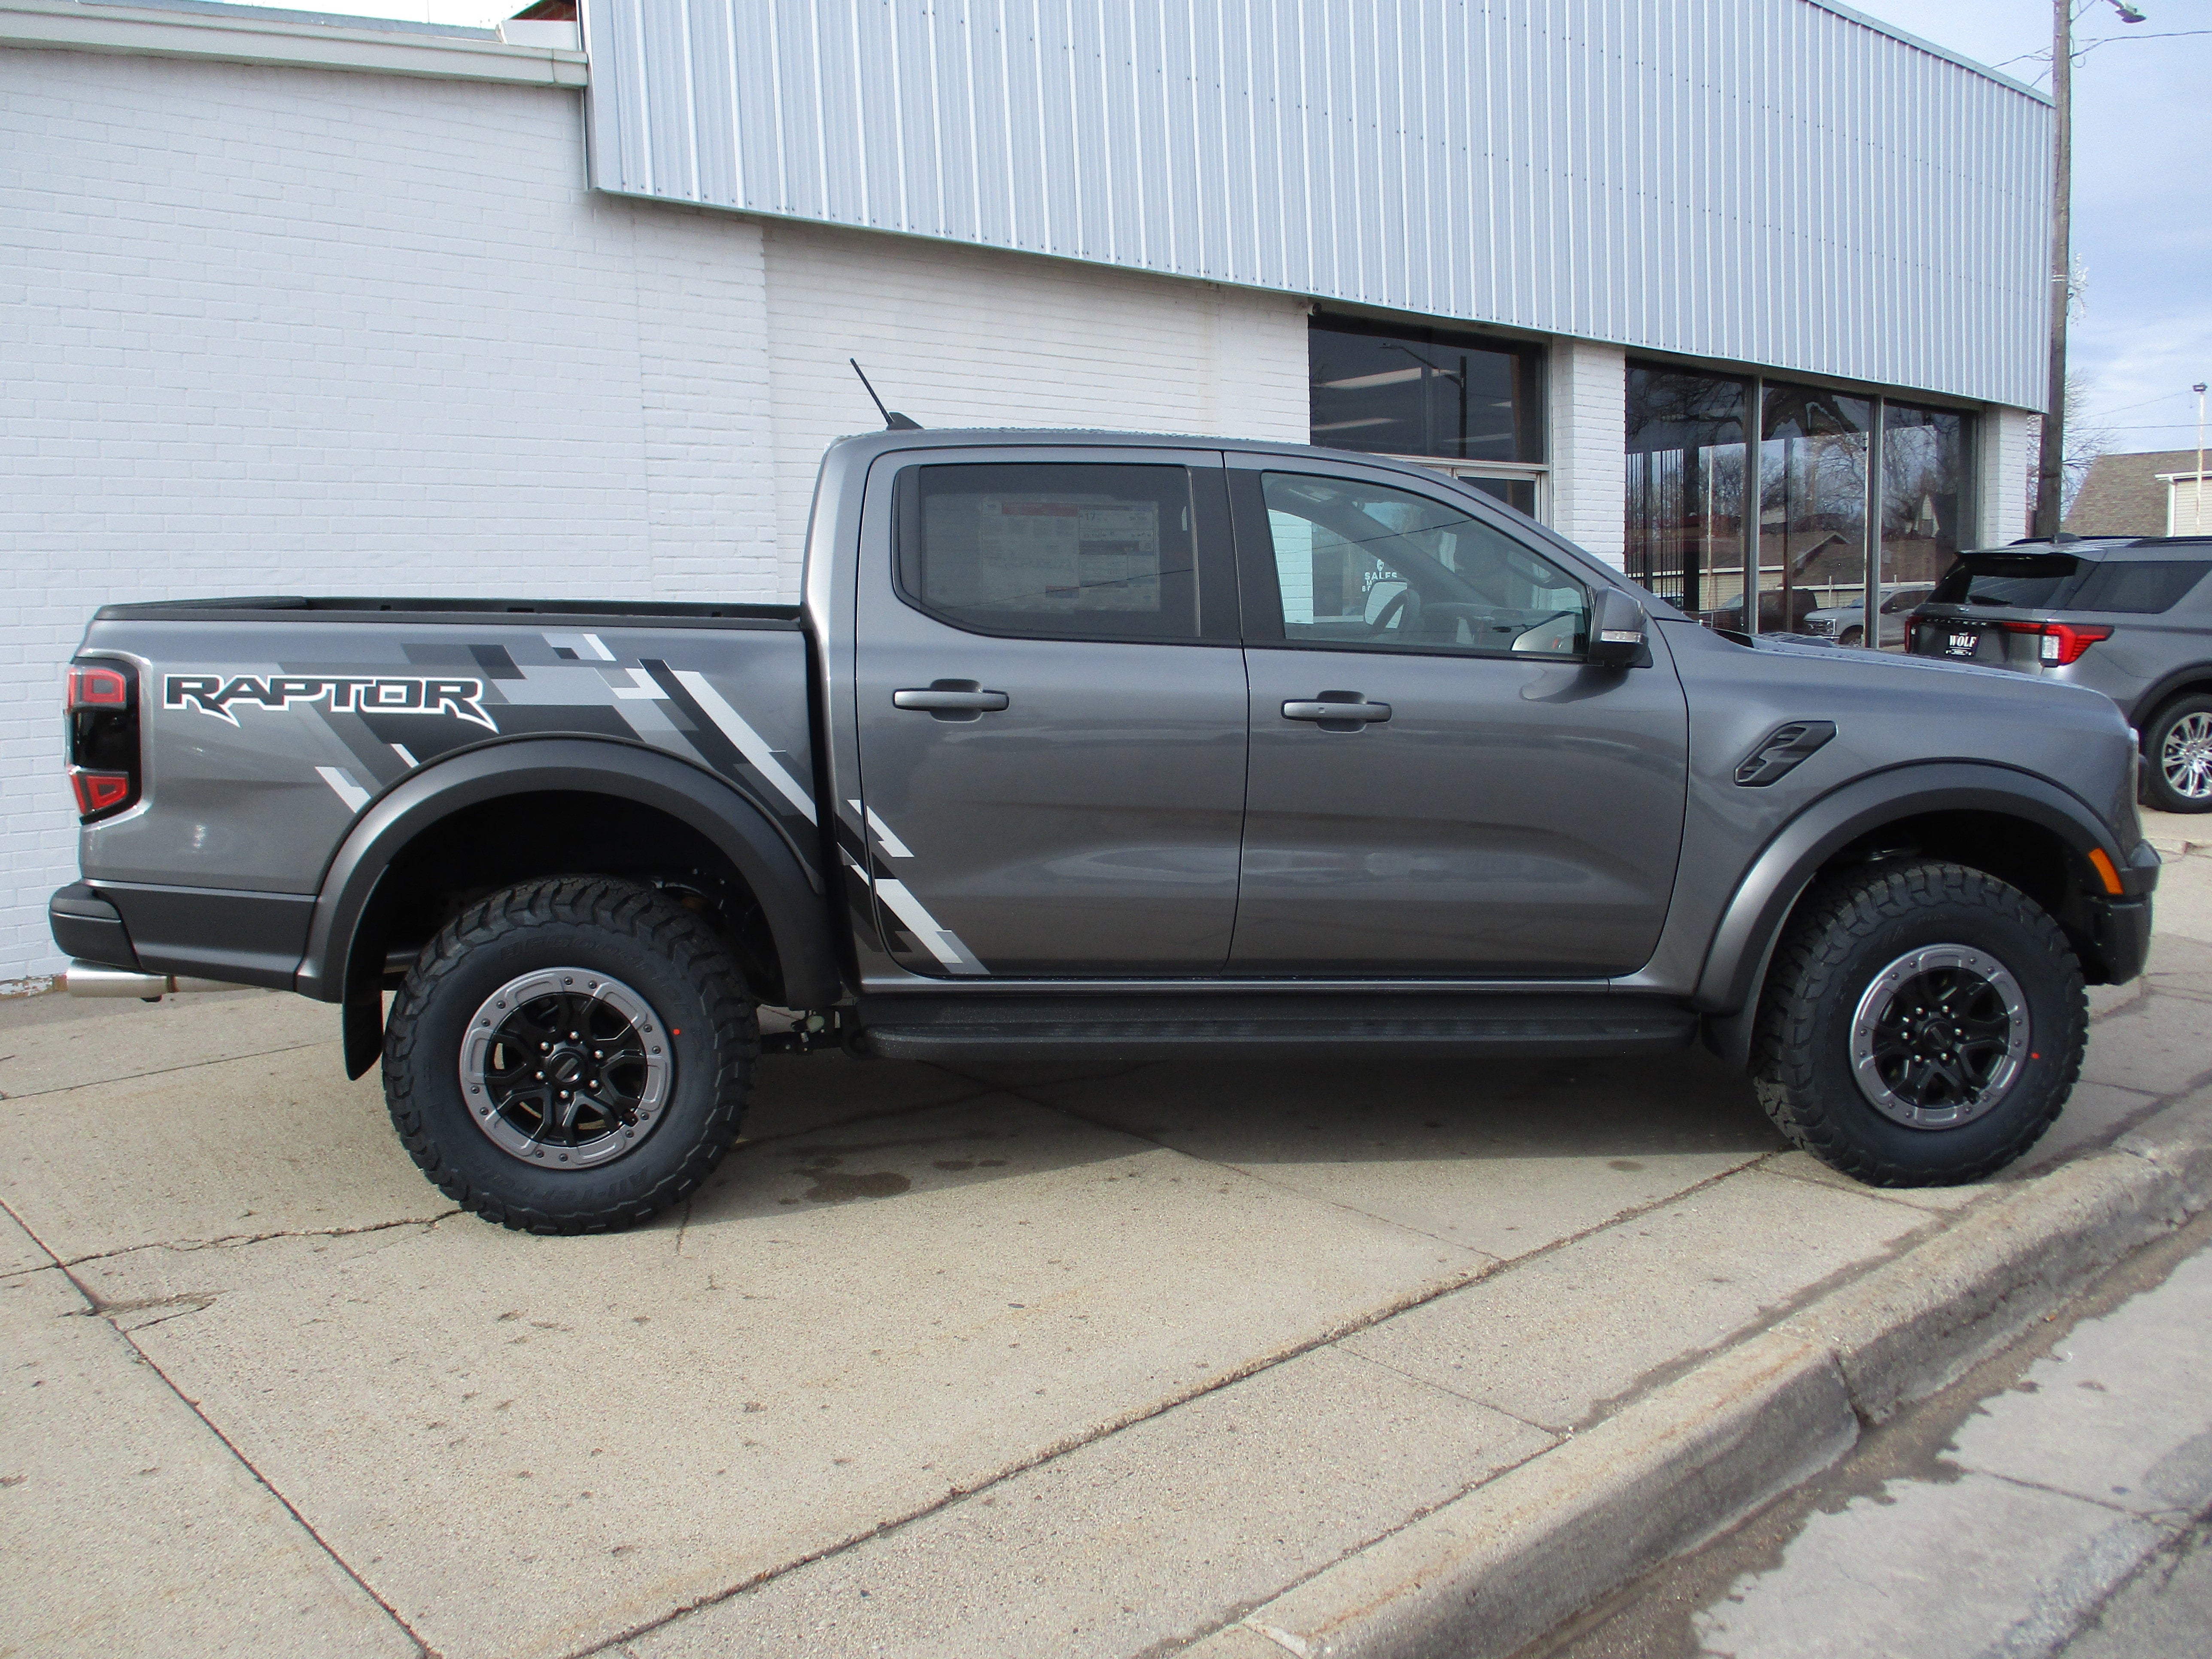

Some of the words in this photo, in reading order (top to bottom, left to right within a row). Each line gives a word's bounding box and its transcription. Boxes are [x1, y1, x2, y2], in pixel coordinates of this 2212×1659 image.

[1364, 571, 1397, 580] SALES
[1949, 635, 1976, 647] WOLF
[164, 674, 500, 734] RAPTOR
